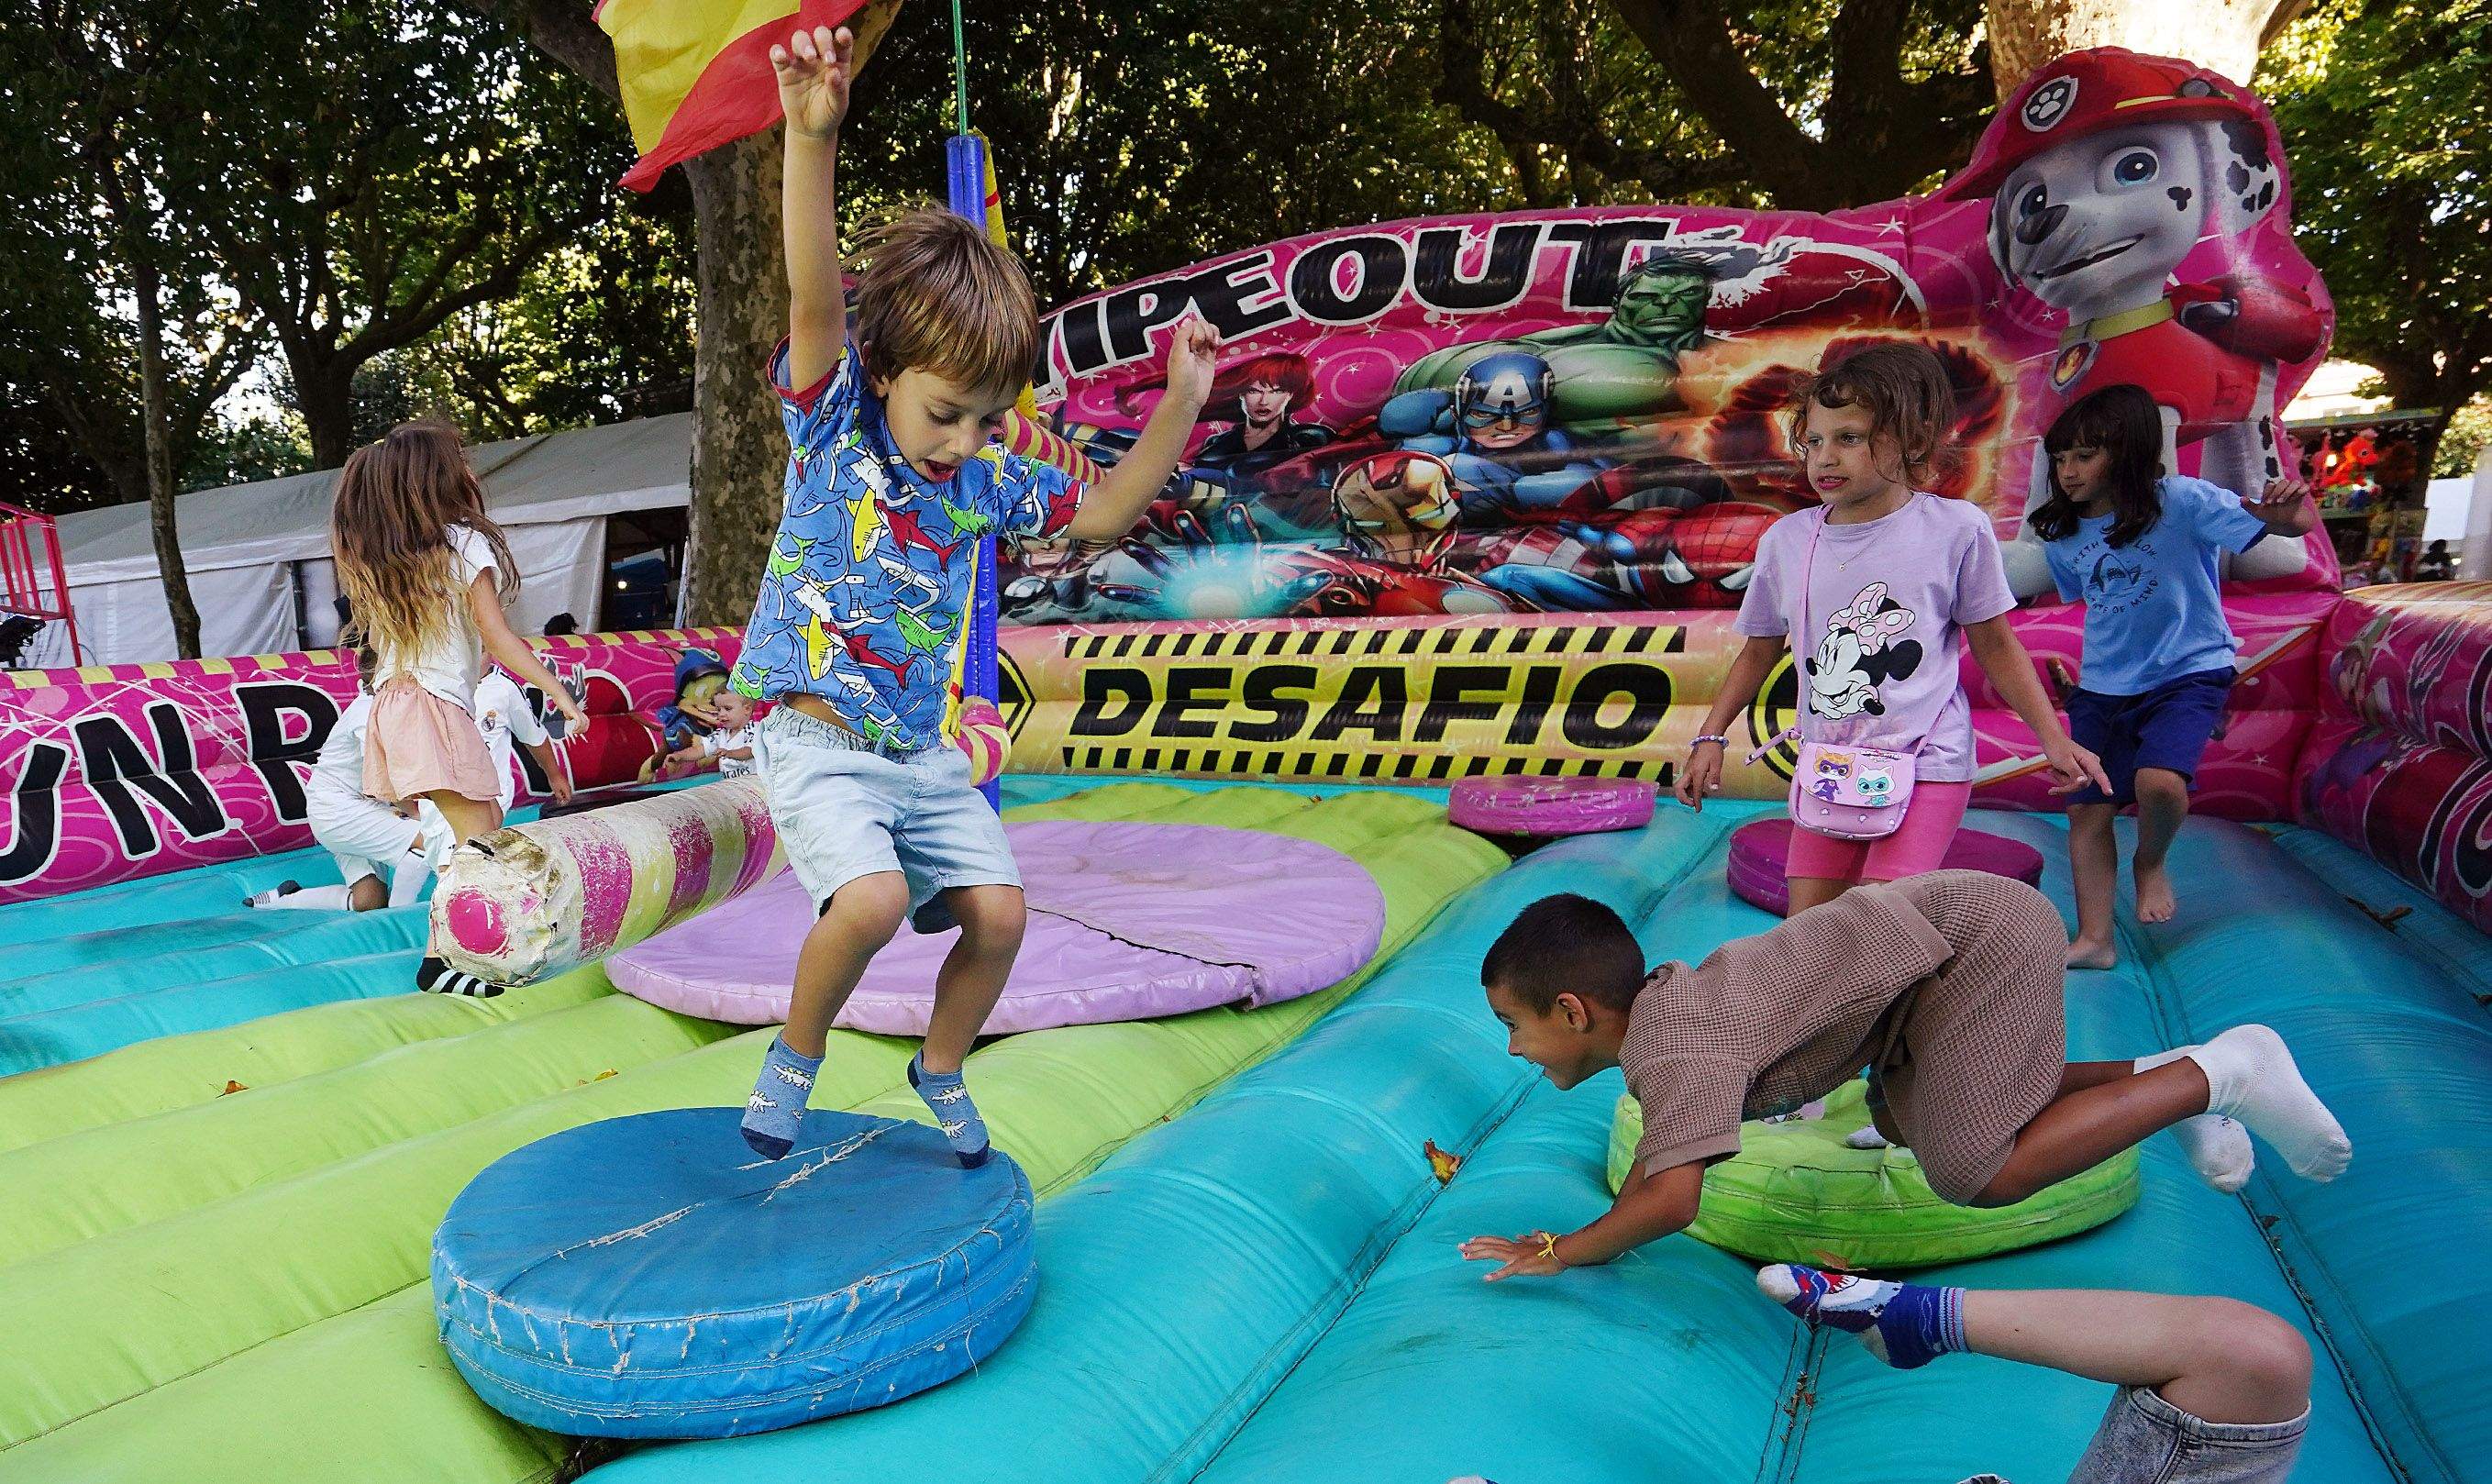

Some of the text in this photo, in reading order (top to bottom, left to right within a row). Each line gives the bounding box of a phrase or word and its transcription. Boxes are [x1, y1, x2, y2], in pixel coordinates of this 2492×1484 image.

[1033, 220, 1678, 388] IPEOUT
[1483, 370, 1533, 409] A
[2112, 604, 2126, 615] OF
[2131, 578, 2158, 608] MIND
[1069, 663, 1672, 750] DESAFIO
